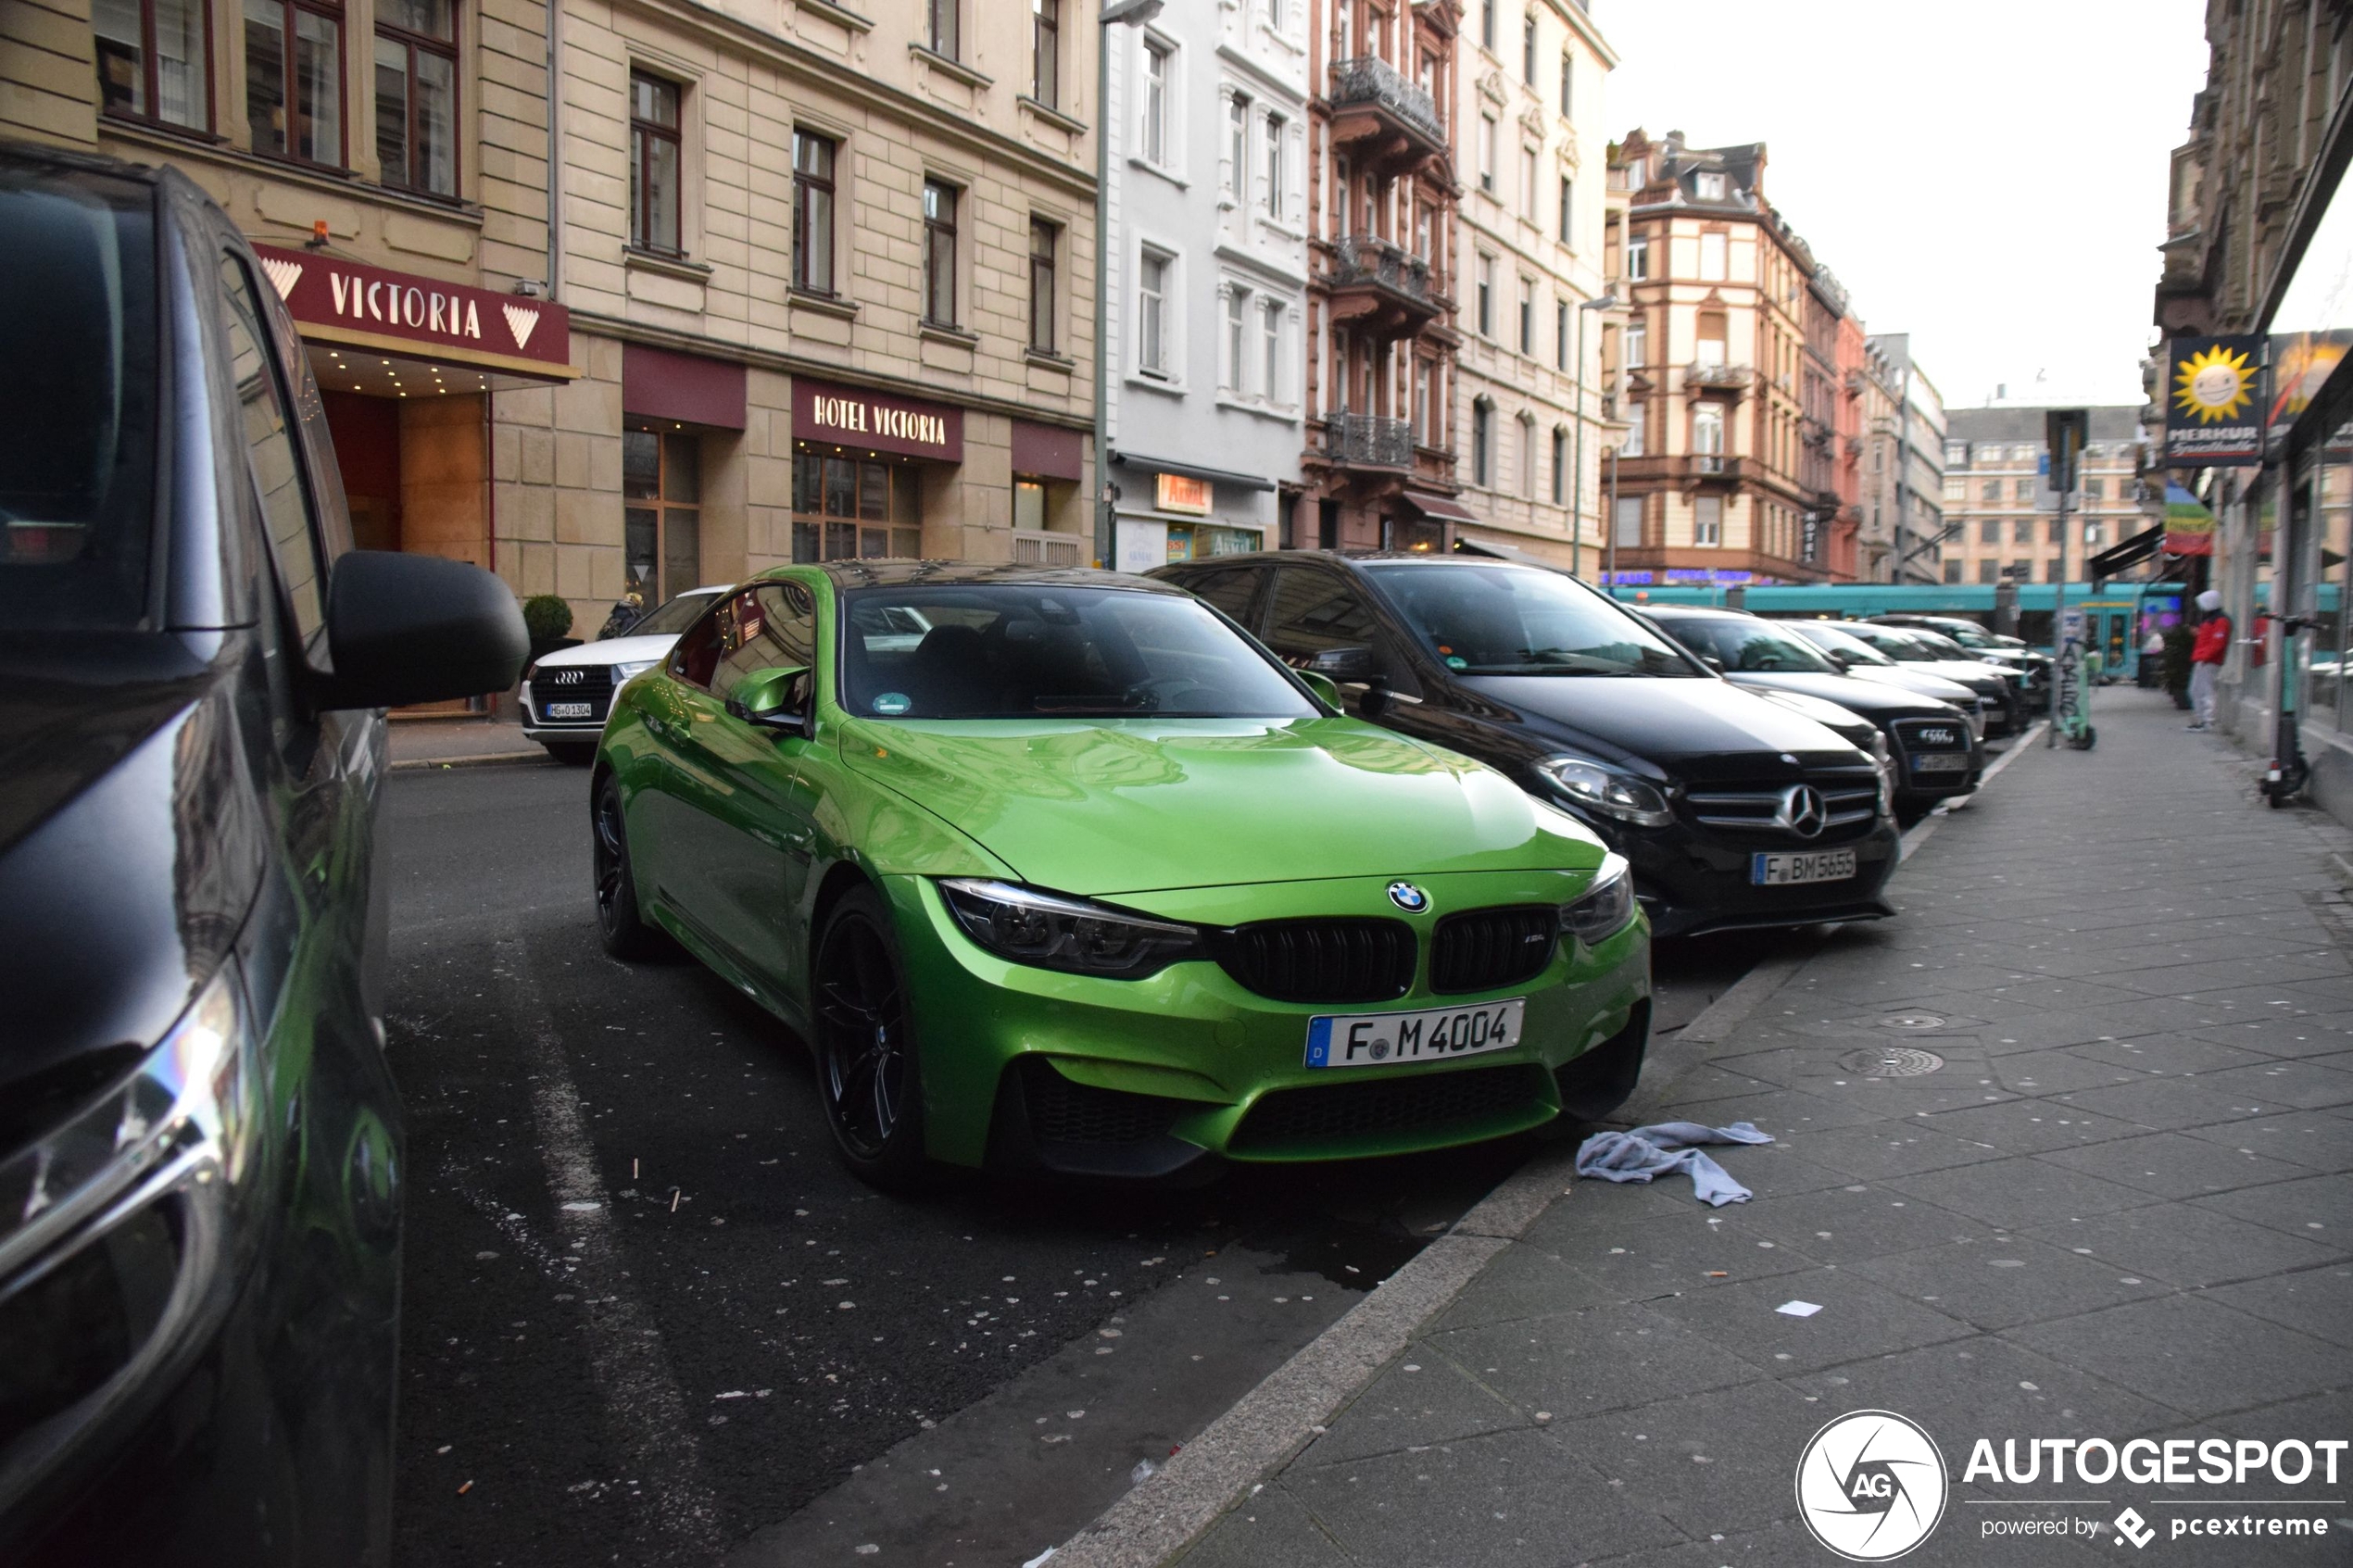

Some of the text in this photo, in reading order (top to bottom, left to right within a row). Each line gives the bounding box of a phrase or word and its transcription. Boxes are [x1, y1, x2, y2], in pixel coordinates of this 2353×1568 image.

[331, 272, 481, 339] VICTORIA
[814, 395, 945, 445] HOTEL VICTORIA
[2169, 426, 2258, 442] MERKUR
